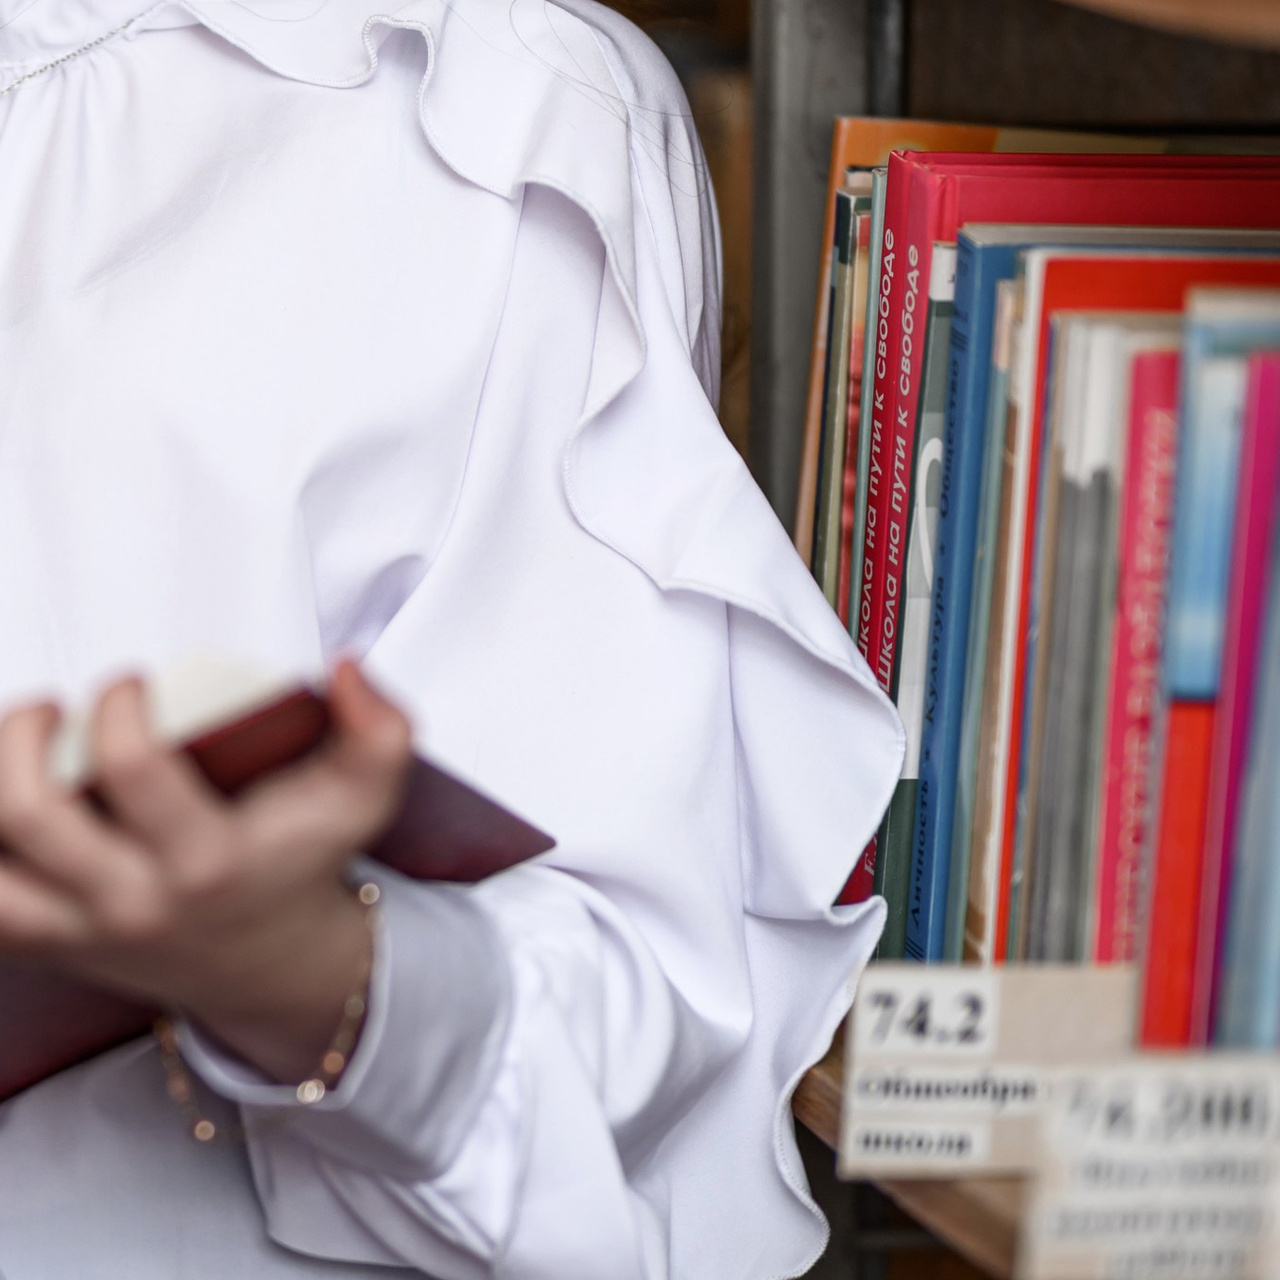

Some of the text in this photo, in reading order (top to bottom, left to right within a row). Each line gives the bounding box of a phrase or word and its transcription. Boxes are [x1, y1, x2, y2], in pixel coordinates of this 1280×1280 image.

[876, 228, 896, 380] свободе
[874, 388, 885, 411] к
[869, 419, 883, 496] пути
[877, 244, 920, 694] Школа на пути к свободе
[865, 504, 878, 549] на
[911, 780, 929, 928] Личность
[924, 577, 945, 724] Культура
[869, 990, 984, 1044] 74.2
